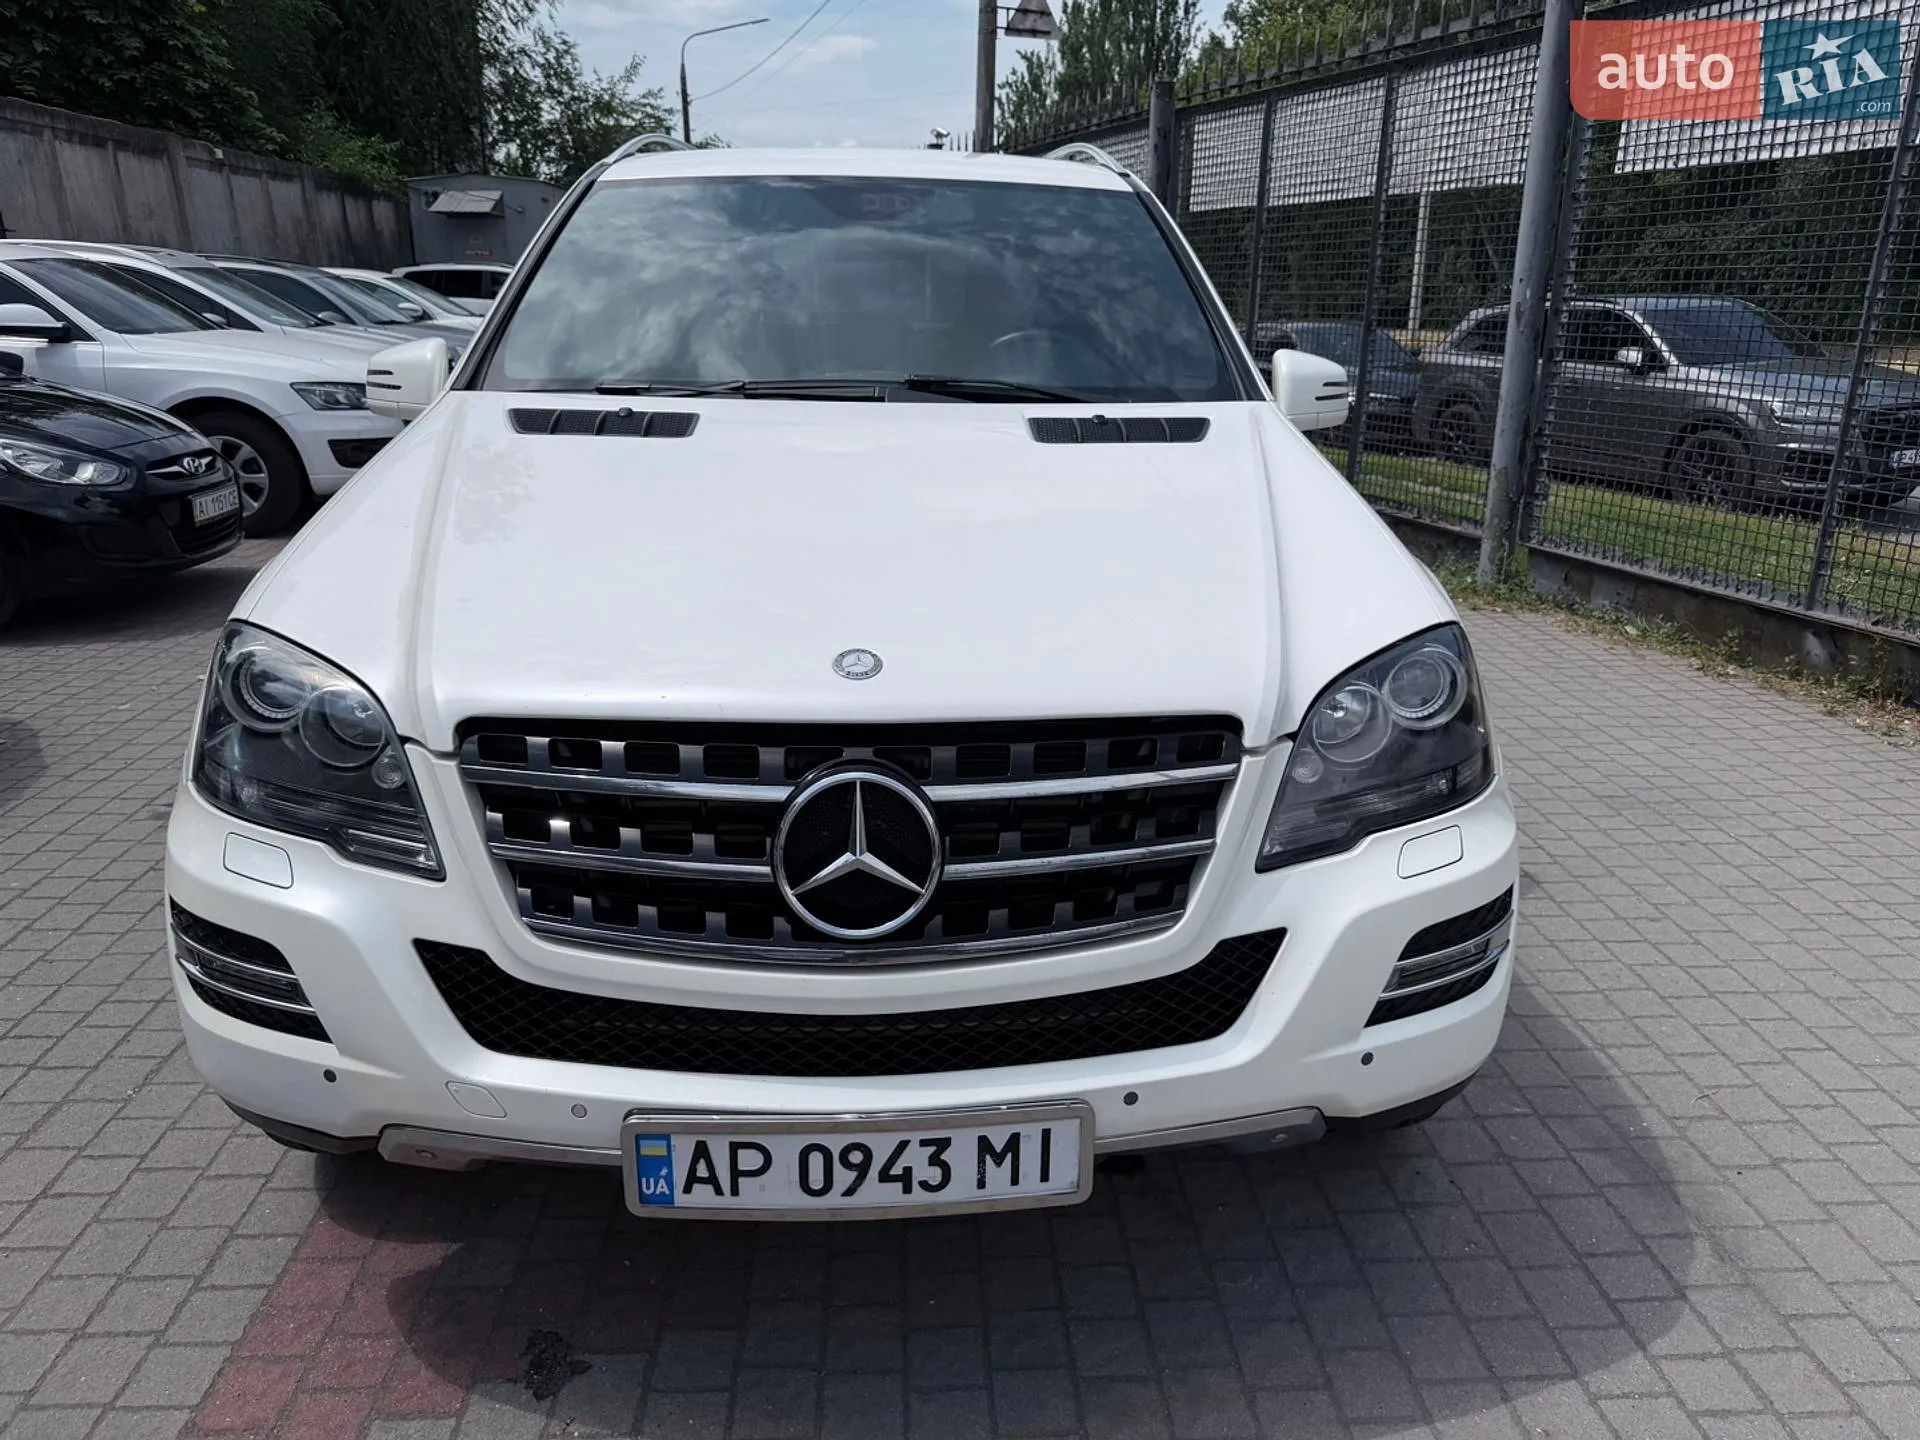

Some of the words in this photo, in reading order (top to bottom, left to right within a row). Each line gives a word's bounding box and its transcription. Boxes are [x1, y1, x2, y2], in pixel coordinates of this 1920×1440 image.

[681, 1139, 773, 1197] AP
[798, 1136, 952, 1197] 0943
[976, 1127, 1052, 1190] MI
[641, 1177, 671, 1195] UA
